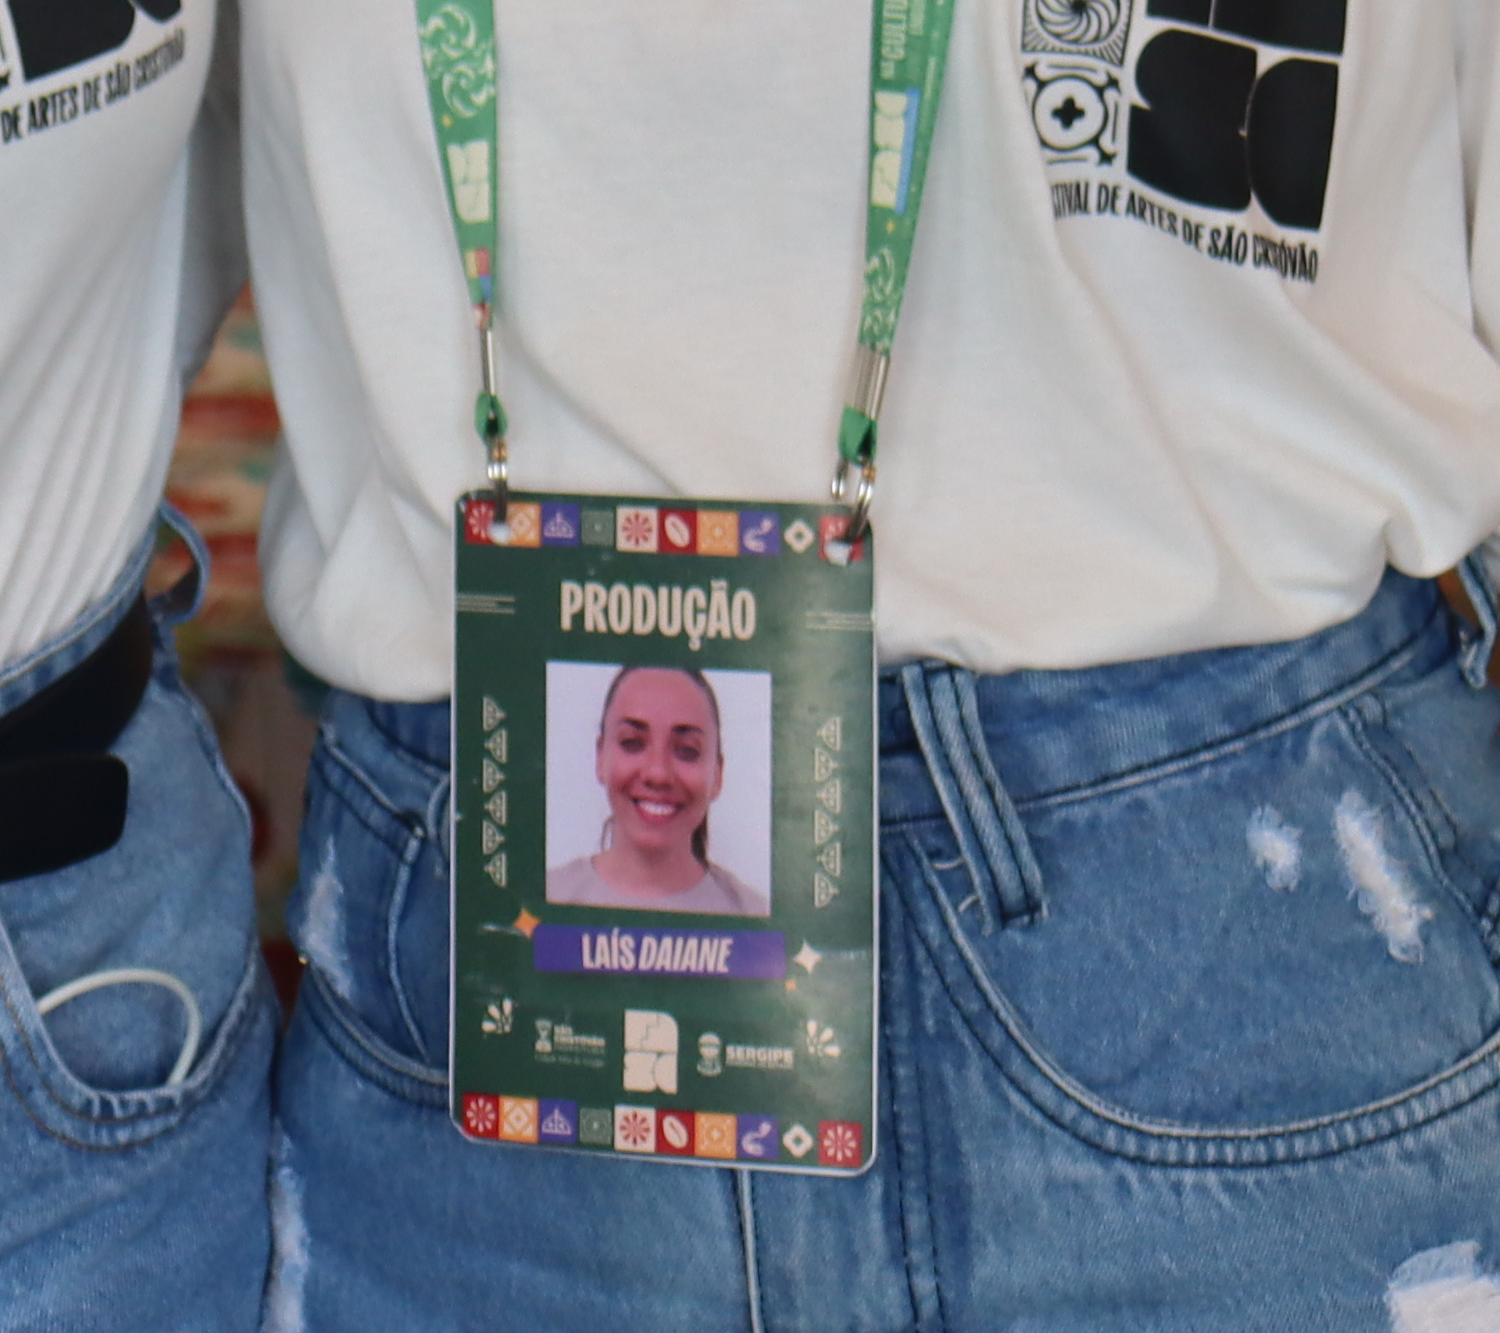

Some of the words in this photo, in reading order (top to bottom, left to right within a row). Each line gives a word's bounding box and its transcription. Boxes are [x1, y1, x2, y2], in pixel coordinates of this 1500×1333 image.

[0, 104, 23, 143] DE
[27, 85, 80, 132] ARTES
[83, 76, 101, 114] DE
[105, 60, 132, 103] SÃO
[1097, 182, 1121, 216] DE
[1126, 189, 1180, 238] ARTES
[1182, 217, 1204, 251] DE
[1207, 223, 1248, 266] SÃO
[559, 579, 757, 651] PRODUÇÃO
[581, 927, 638, 973] LAÍS
[638, 935, 733, 974] DAIANE
[726, 1044, 794, 1062] SERGIPE
